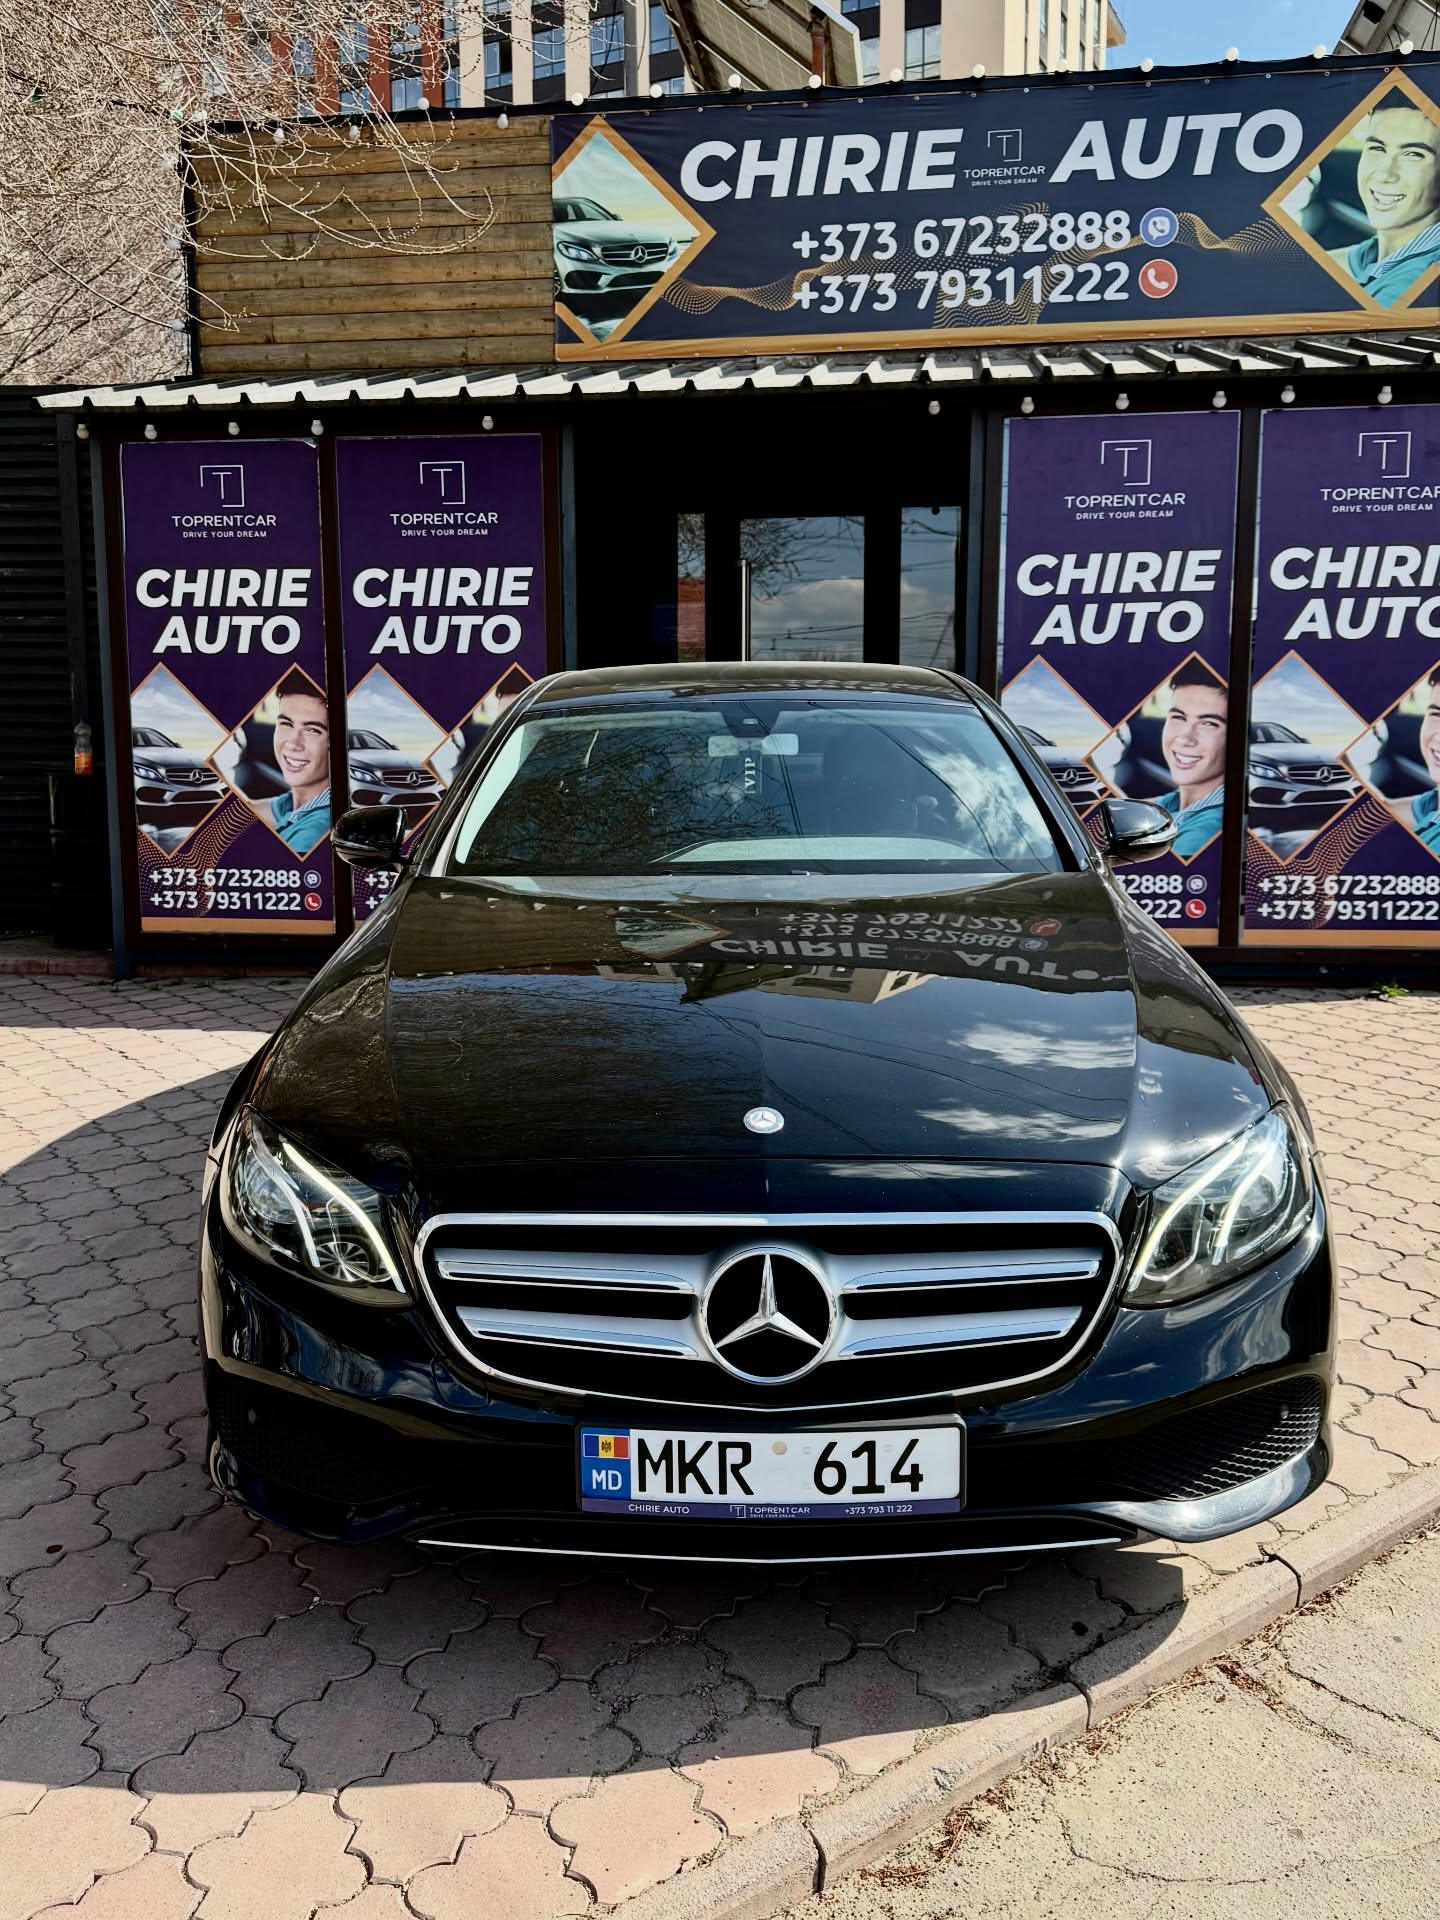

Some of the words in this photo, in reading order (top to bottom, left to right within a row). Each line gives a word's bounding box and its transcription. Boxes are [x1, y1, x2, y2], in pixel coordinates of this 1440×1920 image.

[680, 128, 964, 202] CHIRIE
[1048, 109, 1304, 183] AUTO
[963, 165, 1046, 179] TOPRENTCAR
[792, 221, 898, 263] +373
[913, 209, 1131, 258] 67232888
[792, 272, 898, 314] +373
[916, 261, 1130, 310] 79311222
[1064, 492, 1186, 509] TOPRENTCAR
[1332, 505, 1362, 513] DRIVE
[1366, 504, 1394, 512] YOUR
[1397, 503, 1433, 511] DREAM
[171, 514, 277, 527] TOPRENTCAR
[389, 512, 499, 526] TOPRENTCAR
[1075, 512, 1105, 520] DRIVE
[1109, 511, 1136, 519] YOUR
[1138, 510, 1174, 518] DREAM
[237, 530, 267, 538] DREAM
[401, 529, 428, 537] DRIVE
[457, 528, 489, 536] DREAM
[1016, 549, 1222, 597] CHIRIE
[1270, 544, 1440, 590] CHIRI
[135, 568, 312, 608] CHIRIE
[352, 566, 534, 608] CHIRIE
[1030, 600, 1204, 645] AUTO
[152, 615, 301, 655] AUTO
[369, 614, 522, 655] AUTO
[744, 757, 756, 788] VIP
[149, 869, 197, 887] +373
[203, 870, 301, 888] 67232888
[1258, 875, 1316, 896] +373
[1324, 875, 1440, 896] 67232888
[150, 892, 198, 909] +373
[205, 893, 301, 910] 79311222
[1257, 900, 1315, 920] +373
[1325, 900, 1439, 920] 79311222
[637, 1437, 755, 1496] MKR
[812, 1438, 924, 1495] 614
[591, 1468, 623, 1491] MD
[628, 1503, 661, 1513] CHIRIE
[662, 1505, 690, 1514] AUTO
[748, 1506, 810, 1514] TOPRENTCAR
[844, 1506, 866, 1515] +373
[867, 1506, 885, 1514] 793
[886, 1505, 894, 1513] 11
[896, 1504, 913, 1513] 222
